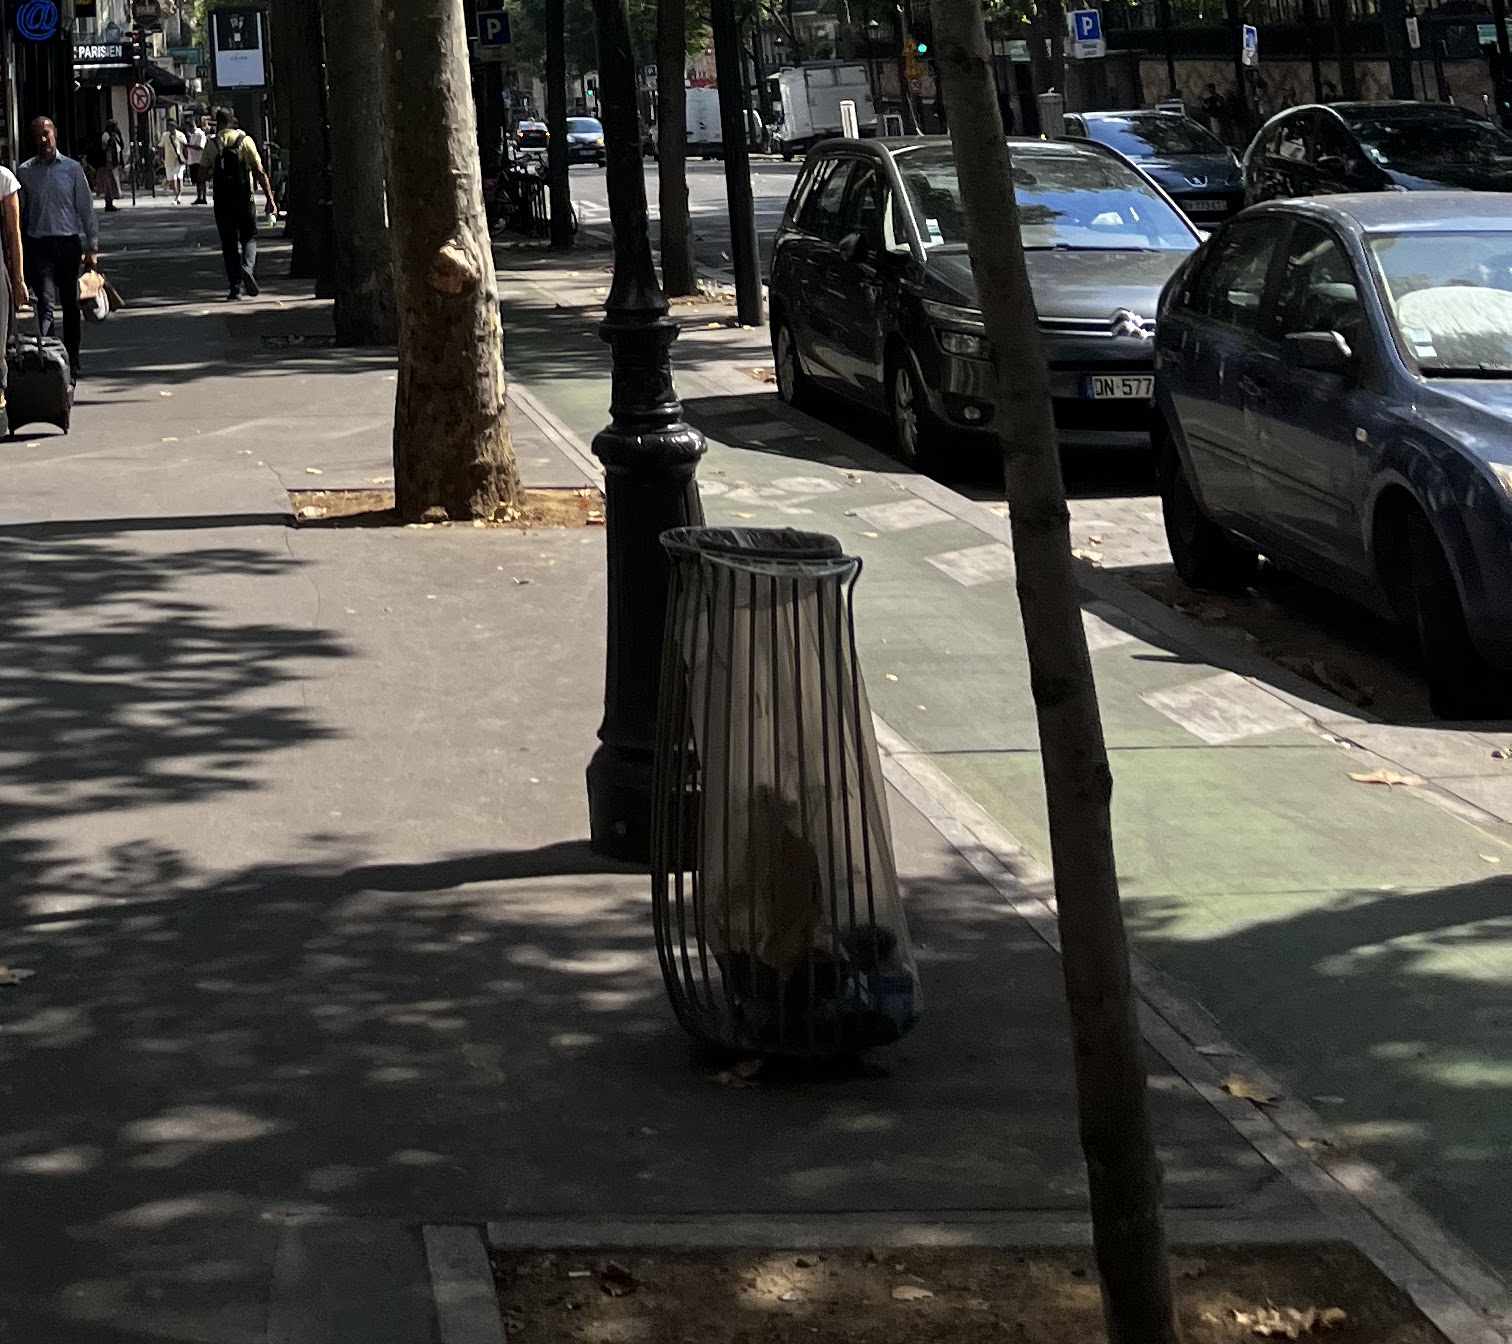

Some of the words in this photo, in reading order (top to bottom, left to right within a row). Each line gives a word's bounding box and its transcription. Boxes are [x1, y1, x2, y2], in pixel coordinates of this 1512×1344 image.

[486, 17, 502, 41] P
[78, 45, 123, 58] PARISIEN
[1094, 377, 1153, 397] DN-577
